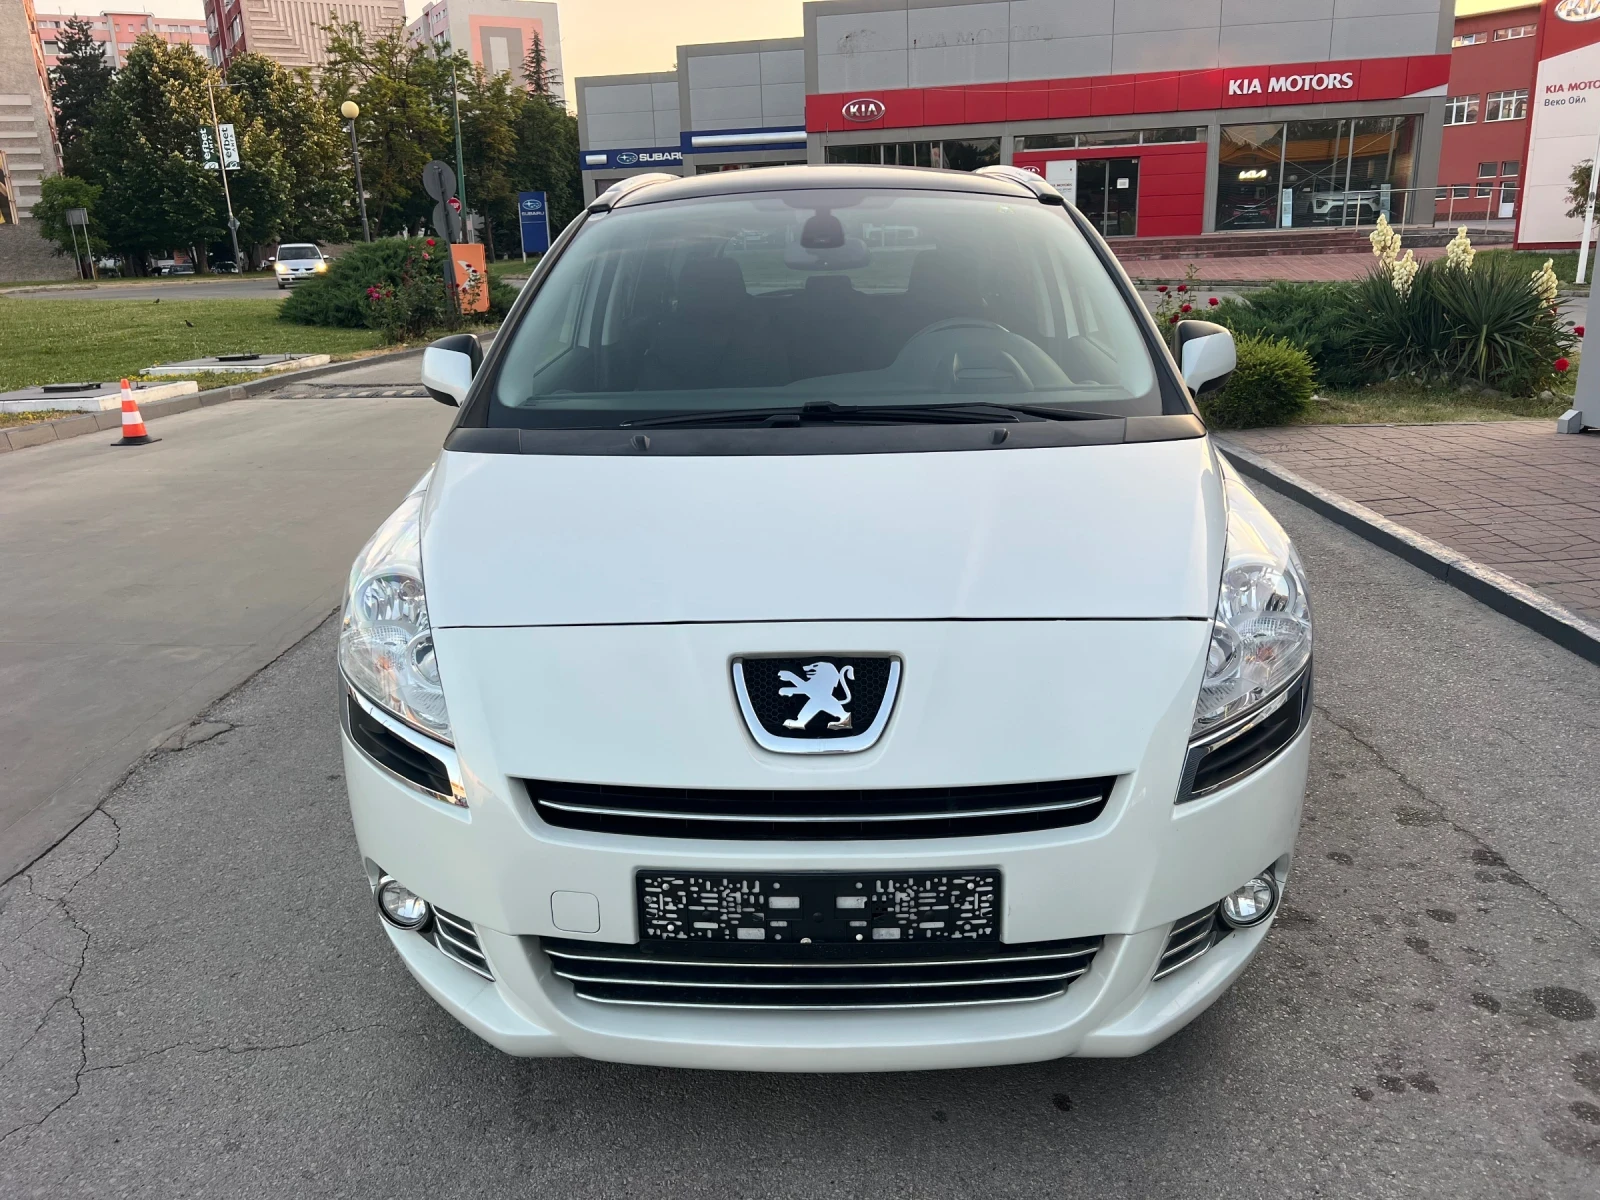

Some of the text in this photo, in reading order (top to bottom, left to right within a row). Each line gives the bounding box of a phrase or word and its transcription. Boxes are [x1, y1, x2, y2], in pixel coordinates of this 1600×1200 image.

[1228, 72, 1353, 95] KIA MOTORS
[1545, 84, 1564, 94] KIA
[849, 103, 878, 117] KIA
[1544, 96, 1586, 106] Веко Ойл
[200, 127, 211, 160] efbet
[222, 127, 232, 158] efbet
